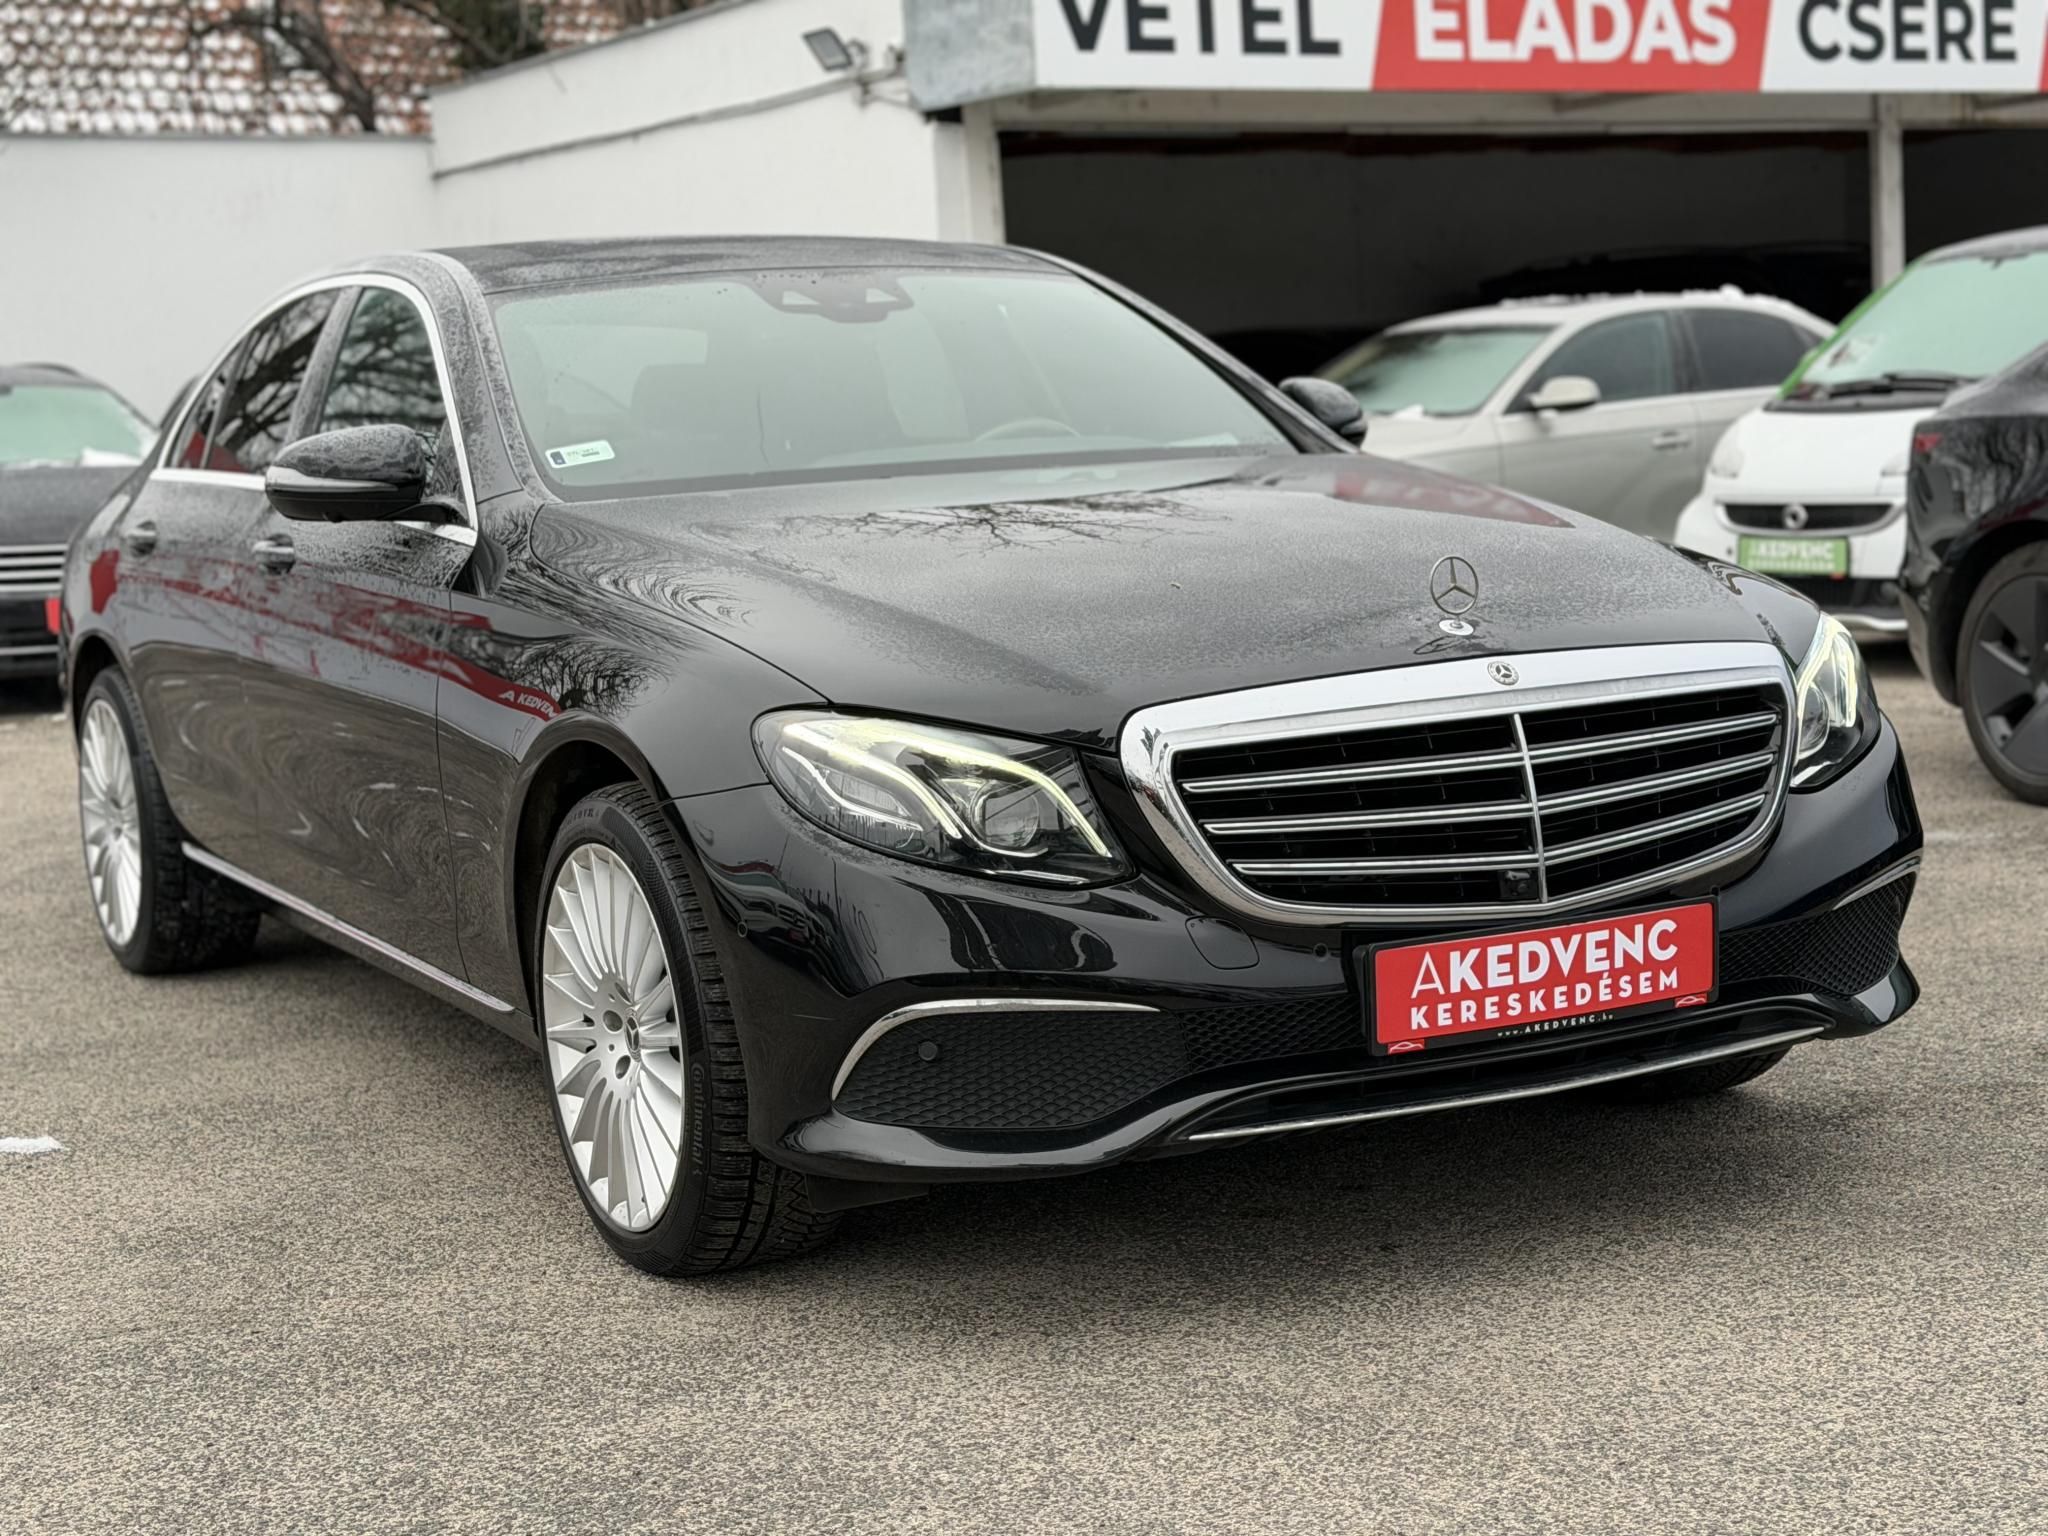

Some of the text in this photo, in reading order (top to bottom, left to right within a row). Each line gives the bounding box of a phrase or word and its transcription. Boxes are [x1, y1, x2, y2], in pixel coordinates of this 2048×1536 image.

[1797, 0, 2017, 63] CSERE
[1411, 919, 1679, 999] AKEDVENC
[1411, 967, 1679, 1031] KERESKEDÉSEM
